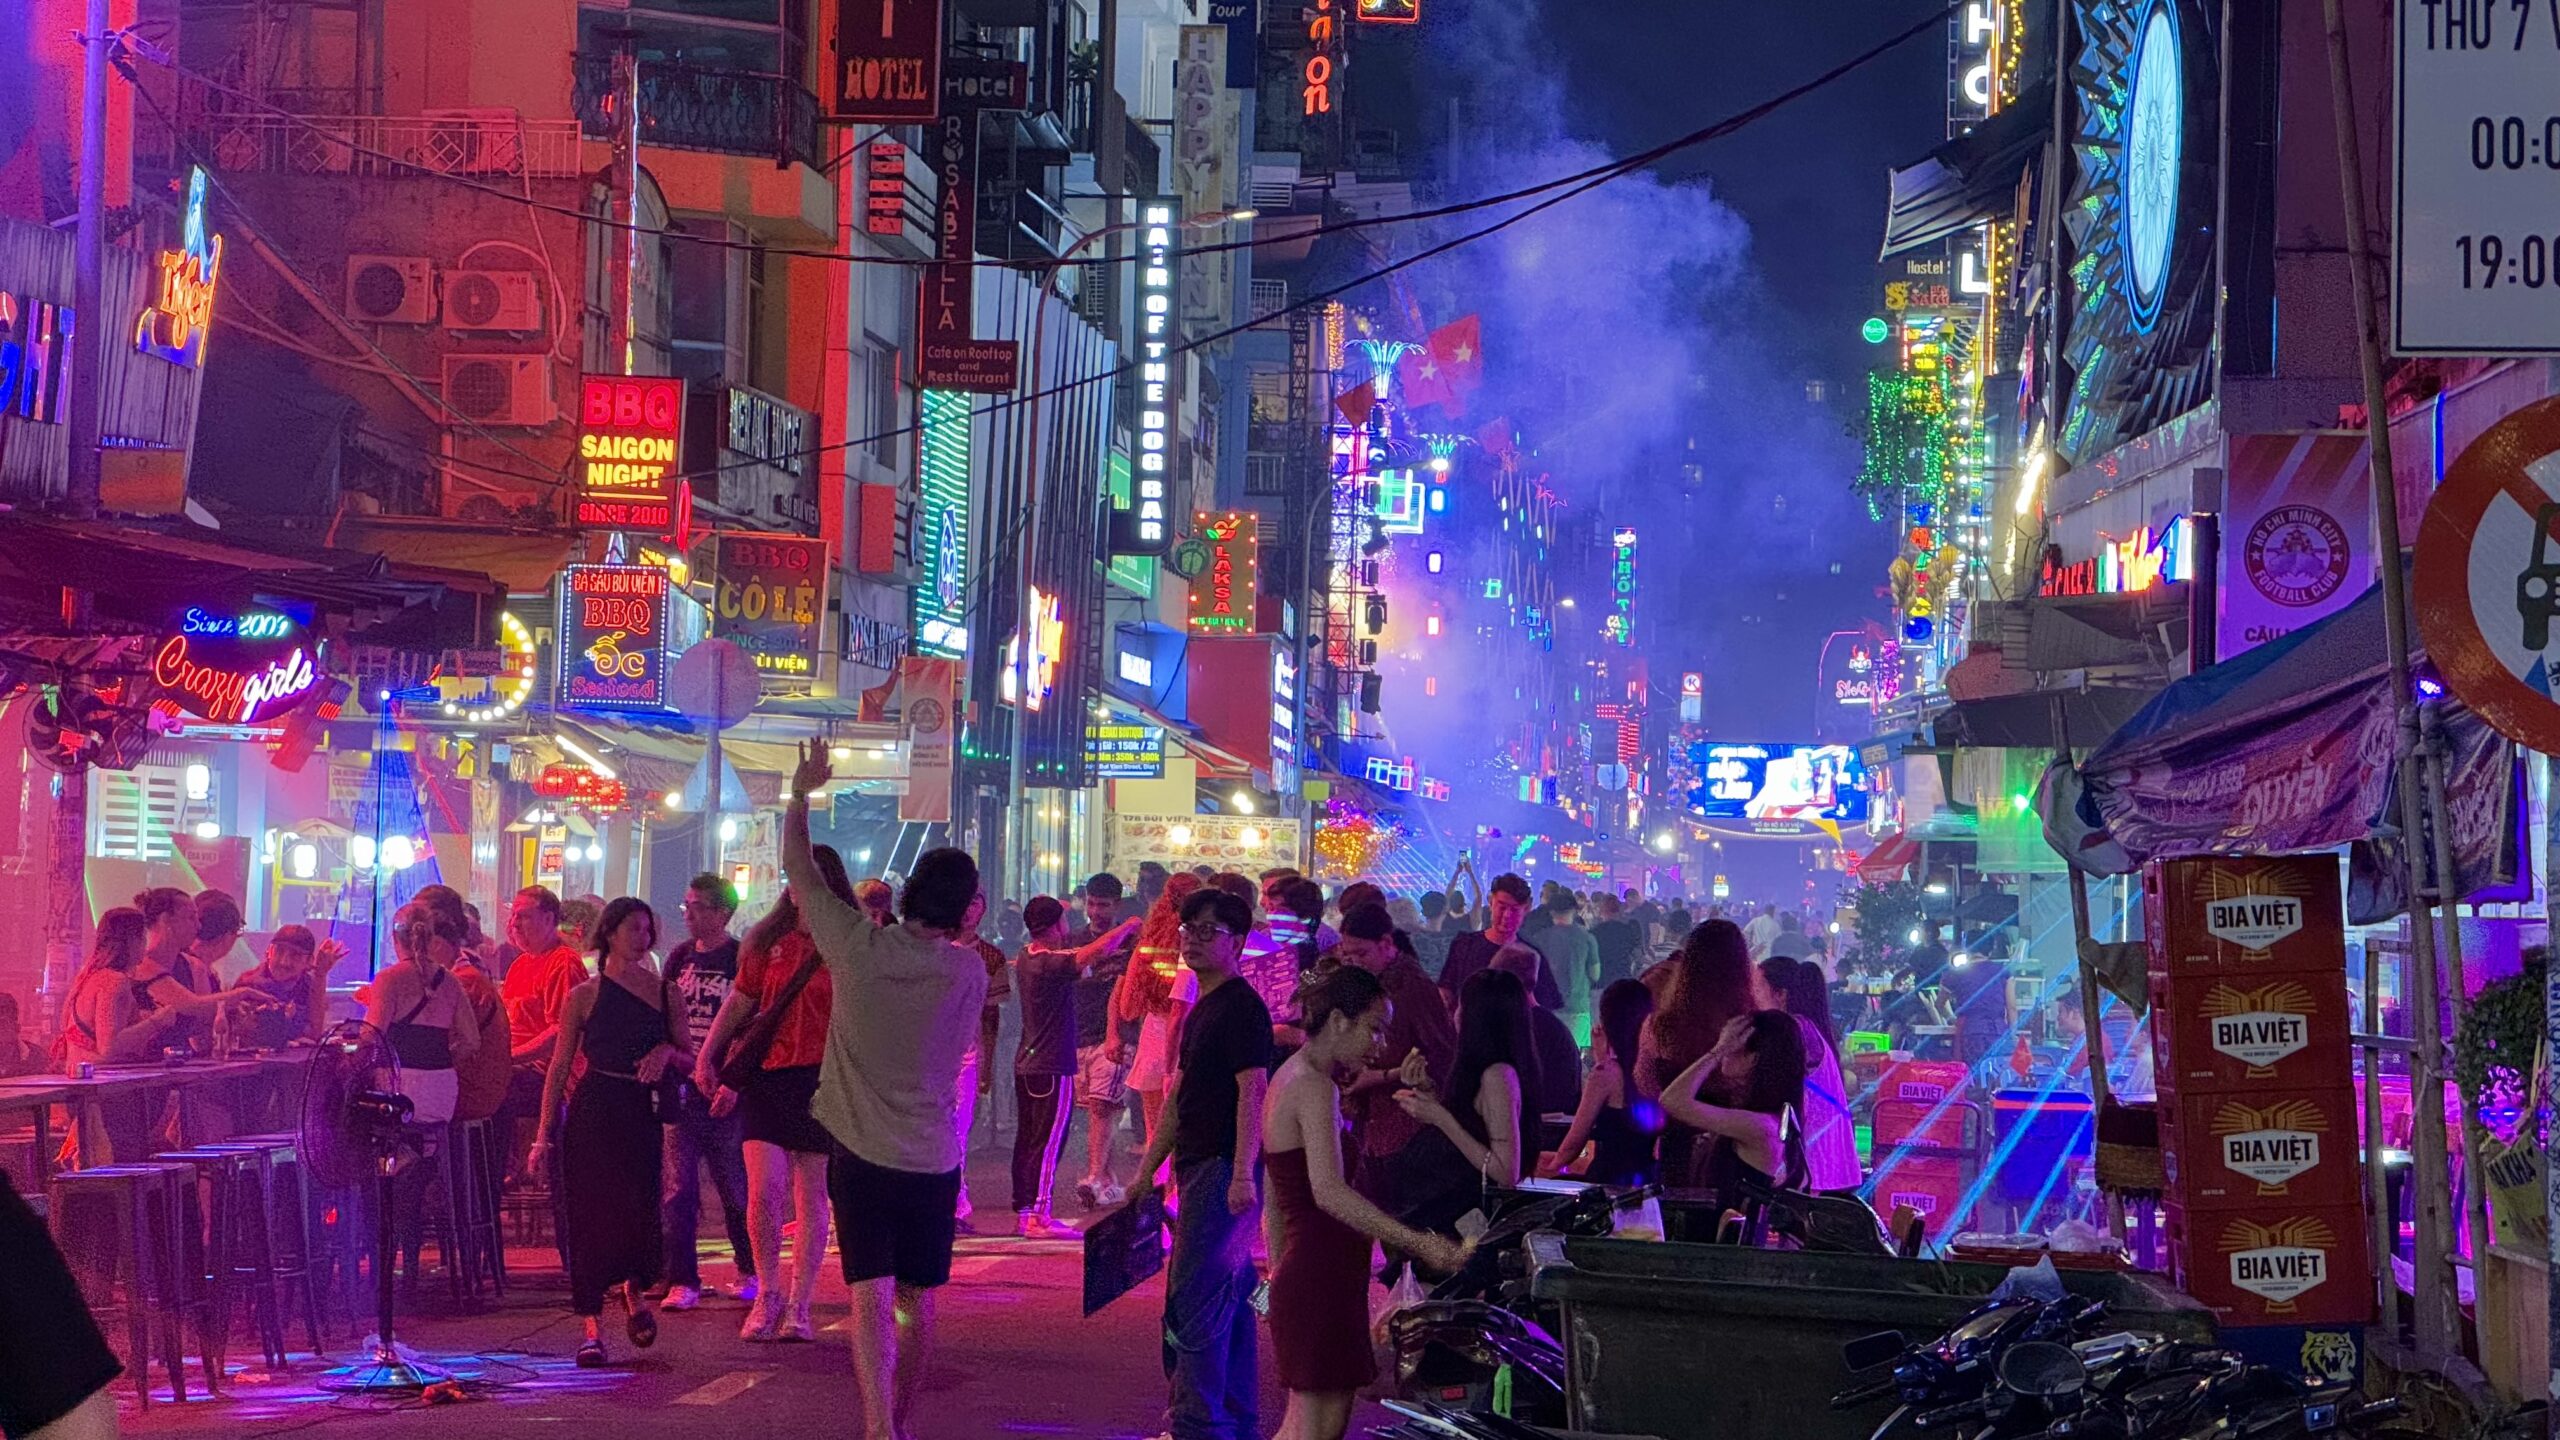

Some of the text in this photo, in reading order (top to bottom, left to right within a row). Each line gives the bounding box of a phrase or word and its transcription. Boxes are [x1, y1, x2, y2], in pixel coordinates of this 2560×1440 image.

[844, 56, 927, 100] HOTEL
[945, 75, 1015, 98] Hotel
[1183, 31, 1215, 200] HAPPY
[938, 115, 965, 331] ROSABELLA
[1907, 259, 1944, 275] Hostel
[953, 347, 968, 361] on
[968, 345, 1013, 365] Rooftop
[958, 361, 981, 372] and
[926, 369, 1010, 385] Restaurant
[1140, 207, 1170, 540] HAIR OF THE DOG BAR
[583, 382, 677, 431] BBQ
[581, 434, 675, 462] SAIGON
[587, 462, 664, 489] NIGHT
[578, 502, 669, 525] SINCE 2010
[2252, 509, 2342, 548] HO CHI MINH CITY
[733, 542, 810, 573] BBQ
[574, 568, 589, 592] BÀ
[590, 567, 612, 593] SÁU
[612, 569, 630, 593] BÙI
[1213, 546, 1232, 614] LAKSA
[2253, 569, 2340, 601] FOOTBALL CLUB
[719, 575, 767, 620] CÔ
[183, 607, 234, 634] Since
[583, 597, 652, 635] BBQ
[848, 613, 876, 666] ROSA
[155, 635, 314, 723] Crazy girls
[774, 653, 809, 675] VIỆN
[571, 675, 655, 699] Seafood
[2212, 899, 2297, 930] BIA VIỆT
[2217, 1017, 2302, 1047] BIA VIỆT
[1902, 1084, 1920, 1097] BIA
[2229, 1134, 2313, 1165] BIA VIỆT
[2237, 1251, 2321, 1281] BIA VIỆT
